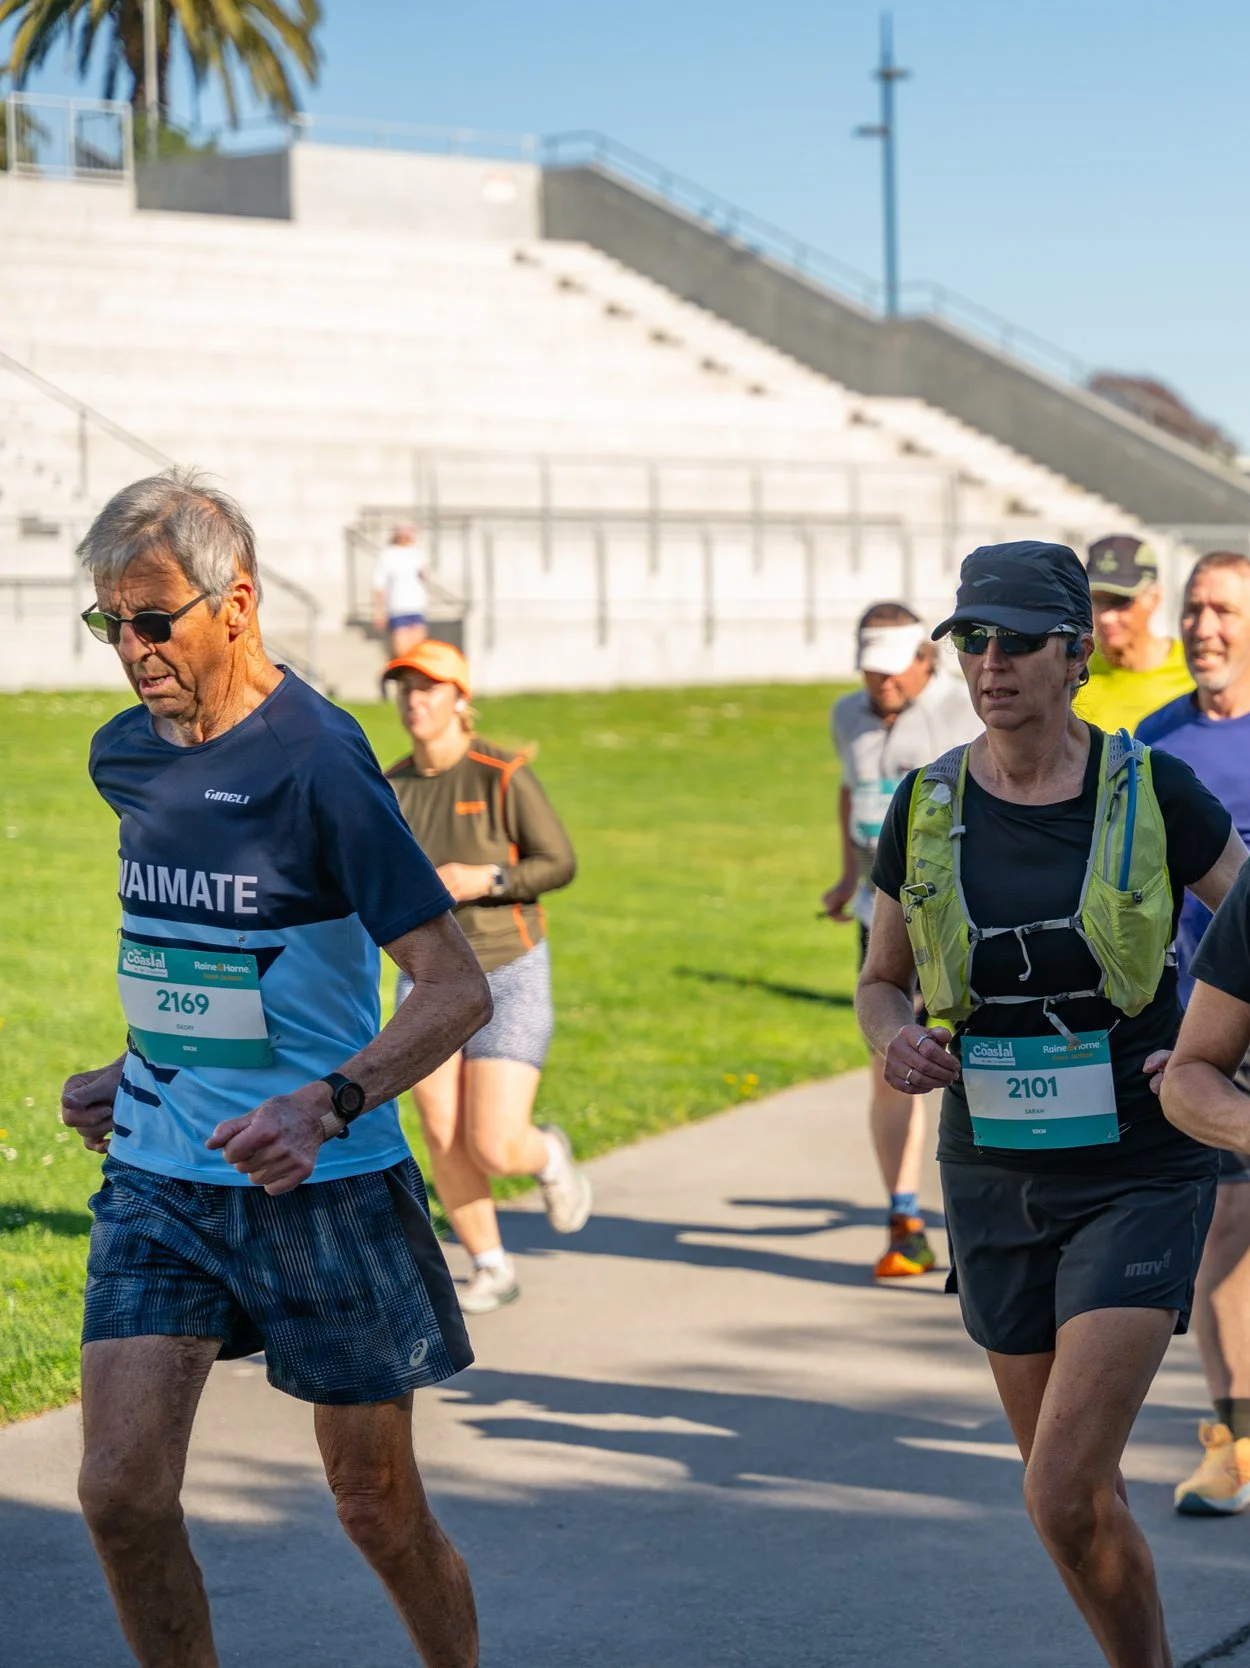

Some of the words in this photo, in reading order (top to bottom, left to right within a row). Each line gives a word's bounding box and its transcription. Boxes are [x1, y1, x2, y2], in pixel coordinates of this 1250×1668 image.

[156, 989, 210, 1015] 2169
[973, 1040, 1013, 1057] Coastal
[1006, 1076, 1058, 1099] 2101
